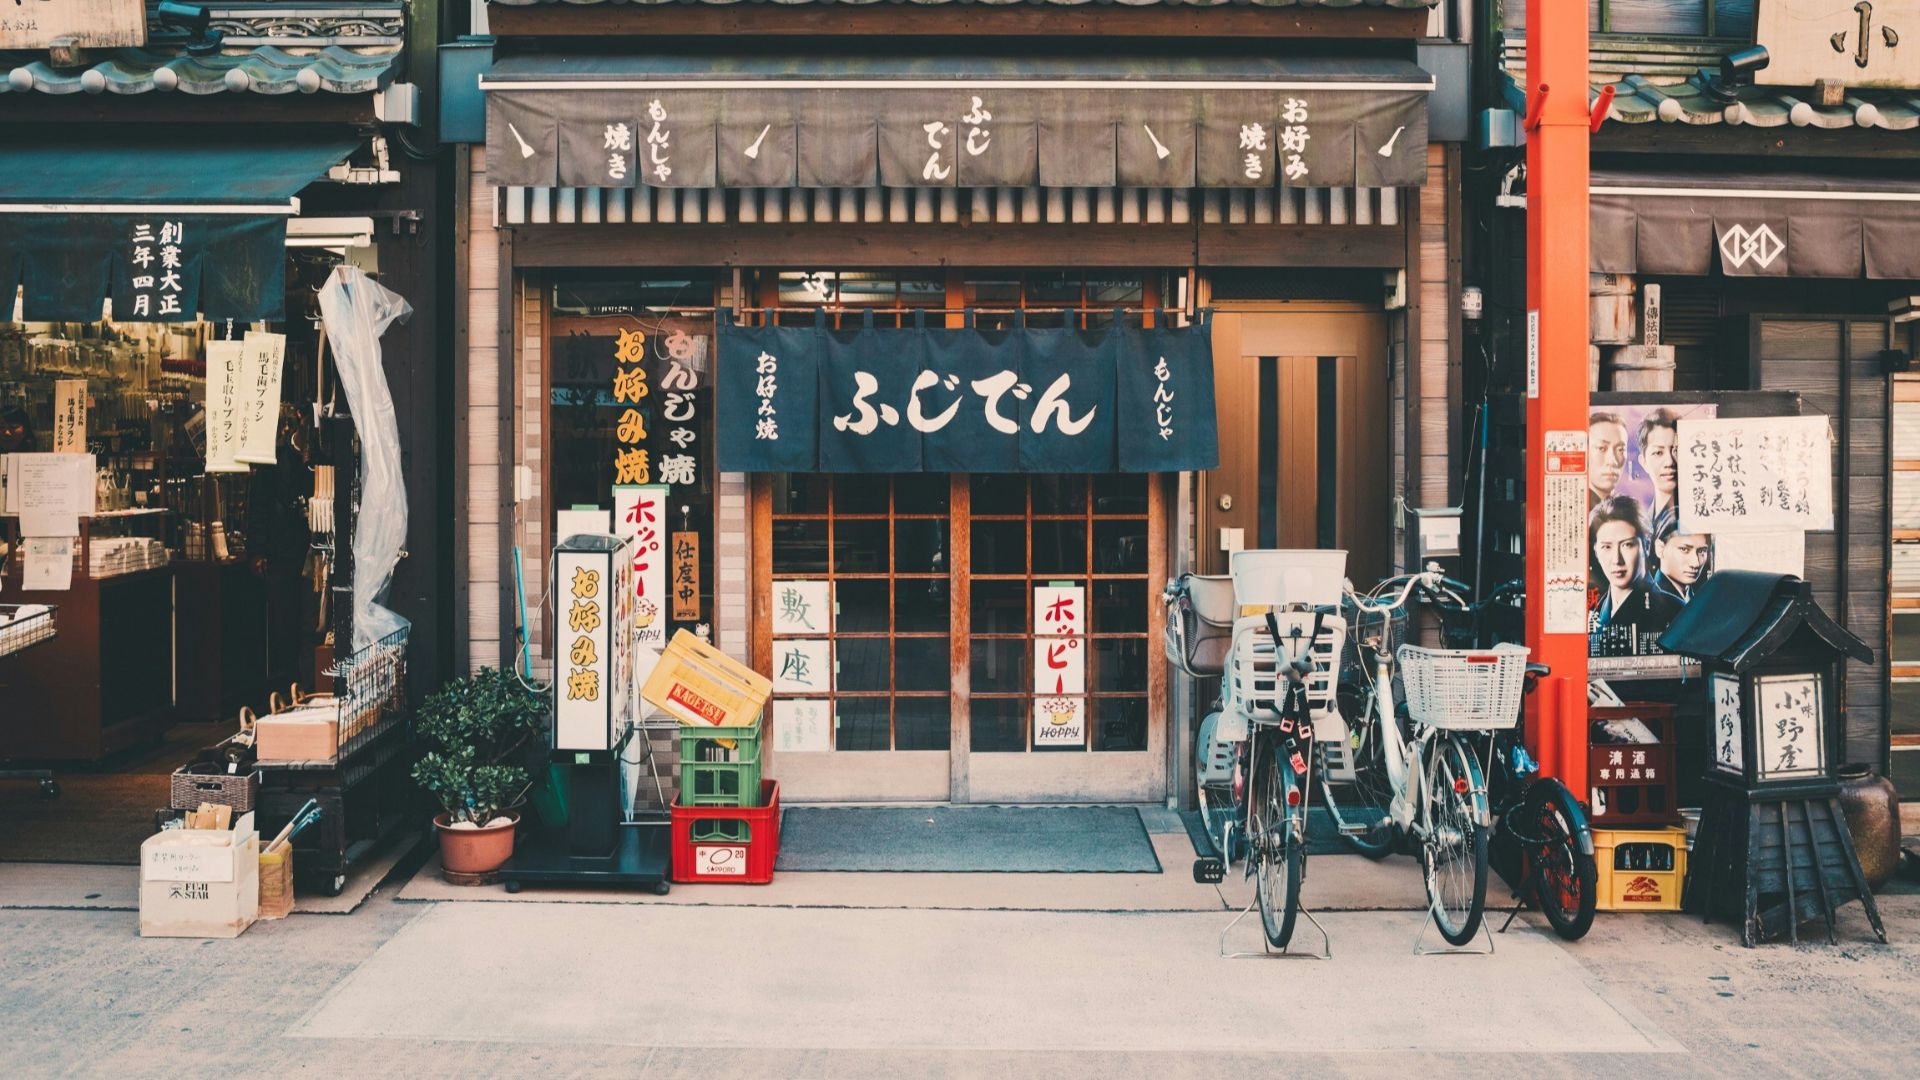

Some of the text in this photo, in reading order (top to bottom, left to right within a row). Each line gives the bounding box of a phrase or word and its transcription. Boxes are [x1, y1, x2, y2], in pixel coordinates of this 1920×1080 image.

[1830, 1, 1899, 68] 小
[604, 122, 631, 179] 焼き
[647, 99, 672, 182] もんじゃ
[923, 120, 950, 181] でん
[963, 97, 992, 156] ふじ
[1239, 123, 1267, 179] 焼き
[1281, 98, 1310, 180] お好み
[132, 224, 155, 317] 三年四月
[158, 221, 183, 315] 創業大正
[613, 327, 650, 485] お好み焼
[659, 329, 698, 485] もんじゃ焼
[755, 350, 779, 441] お好み焼
[833, 369, 1097, 435] ふじでん
[1153, 356, 1174, 441] もんじゃ
[626, 495, 659, 597] ホッピー
[676, 540, 696, 605] 仕度中
[567, 566, 601, 701] お好み焼
[1045, 593, 1078, 696] ホッピー
[672, 683, 722, 720] KAGETSU
[1775, 691, 1804, 771] 小野屋
[1609, 750, 1645, 765] 清酒
[185, 883, 208, 891] FUJI
[185, 892, 208, 900] STAR
